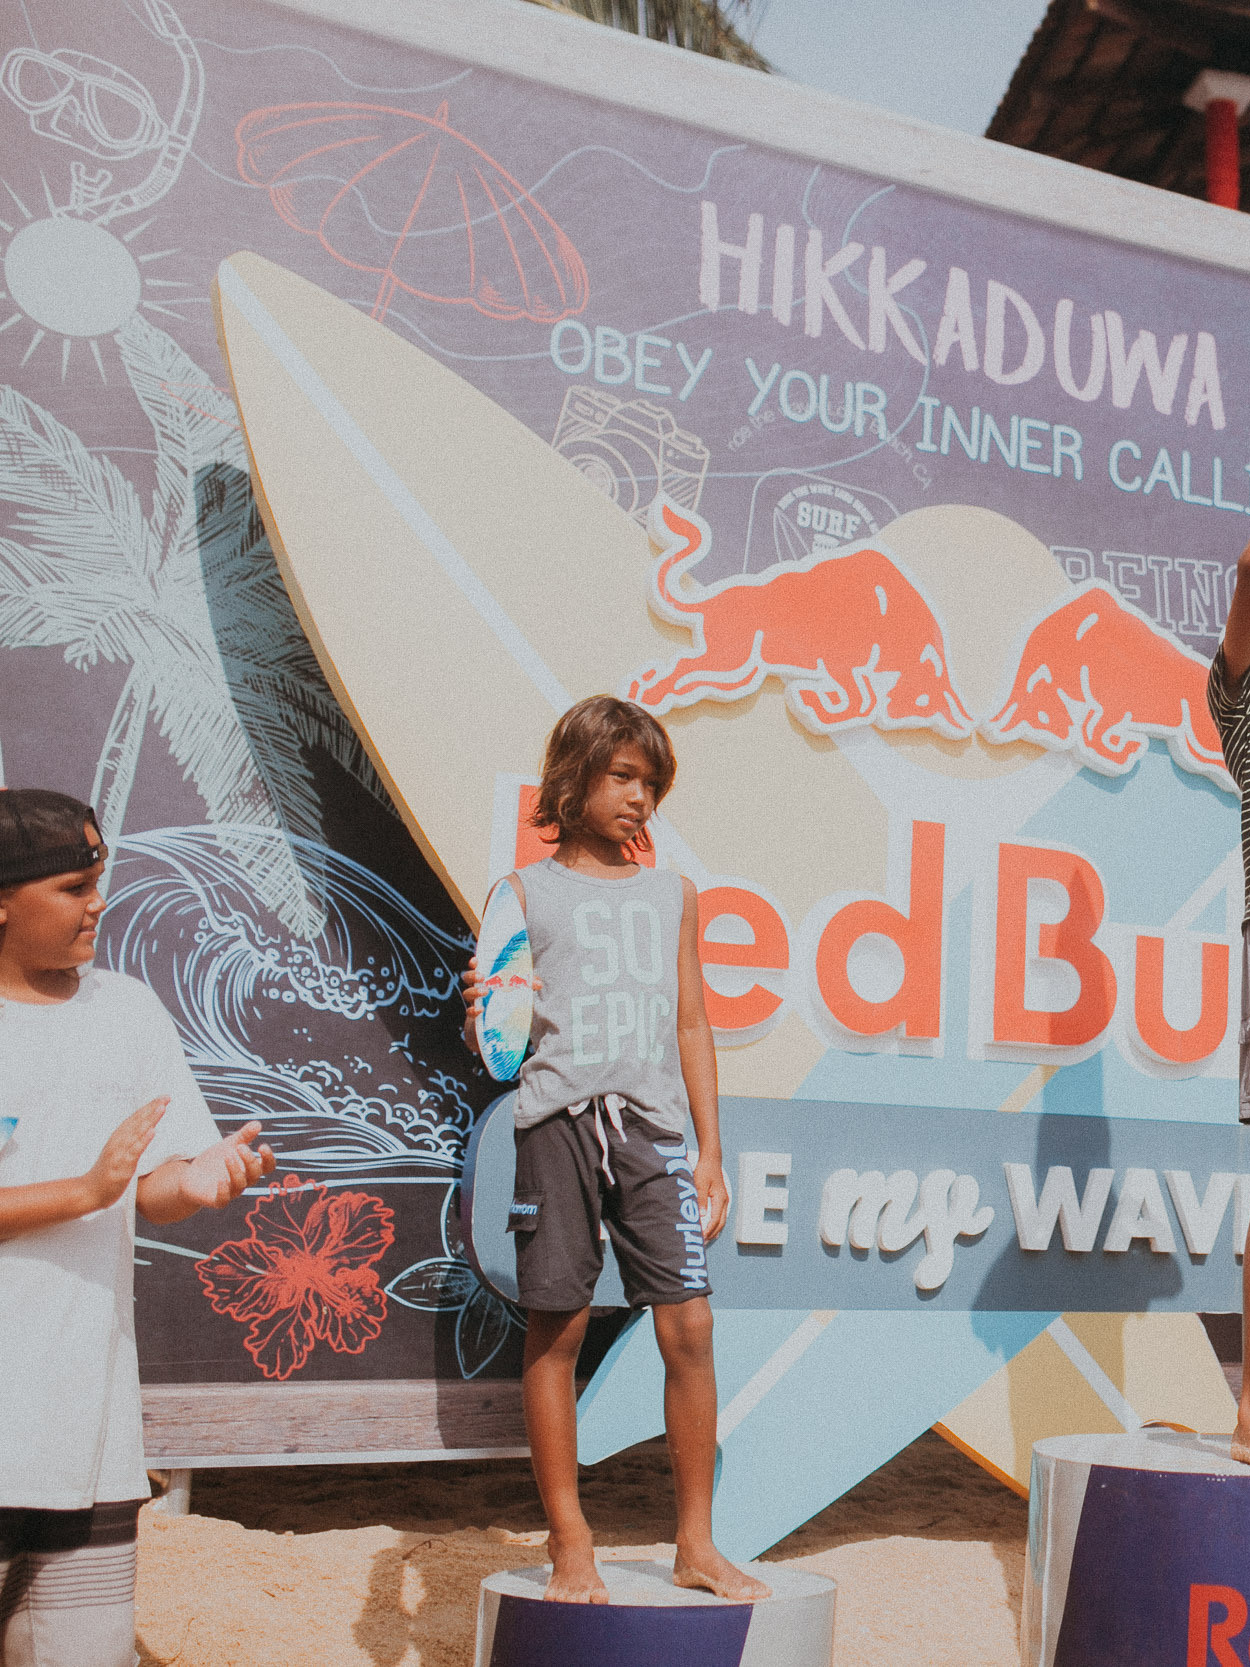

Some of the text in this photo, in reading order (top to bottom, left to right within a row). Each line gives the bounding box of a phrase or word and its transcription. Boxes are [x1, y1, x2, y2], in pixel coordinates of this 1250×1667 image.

[700, 200, 1226, 431] HIKKADUWA
[550, 319, 713, 401] OBEY
[745, 357, 888, 441] YOUR
[916, 395, 1083, 481] INNER
[797, 501, 861, 540] SURF
[573, 900, 664, 987] SO
[571, 991, 671, 1067] EPIC
[675, 1178, 708, 1289] Hurley
[818, 1168, 995, 1290] my
